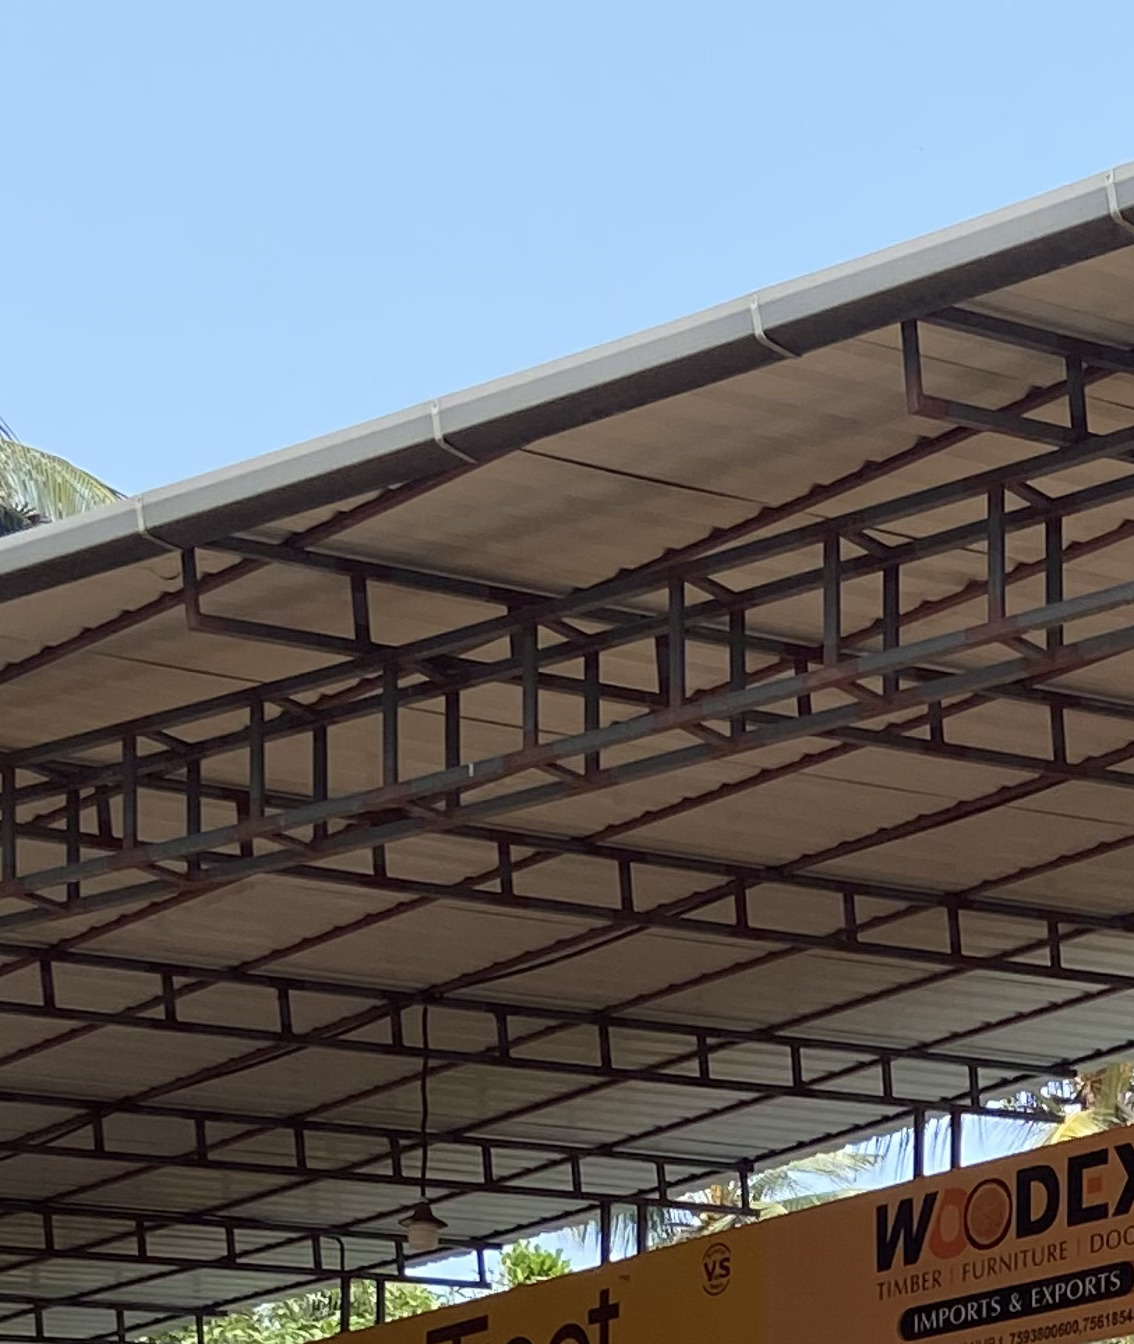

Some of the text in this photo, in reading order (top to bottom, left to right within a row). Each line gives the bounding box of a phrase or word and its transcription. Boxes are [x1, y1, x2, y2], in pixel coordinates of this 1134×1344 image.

[876, 1269, 942, 1300] TIMBER
[962, 1240, 1068, 1282] FURNITURE
[914, 1269, 1121, 1333] IMPORTS & EXPORTS
